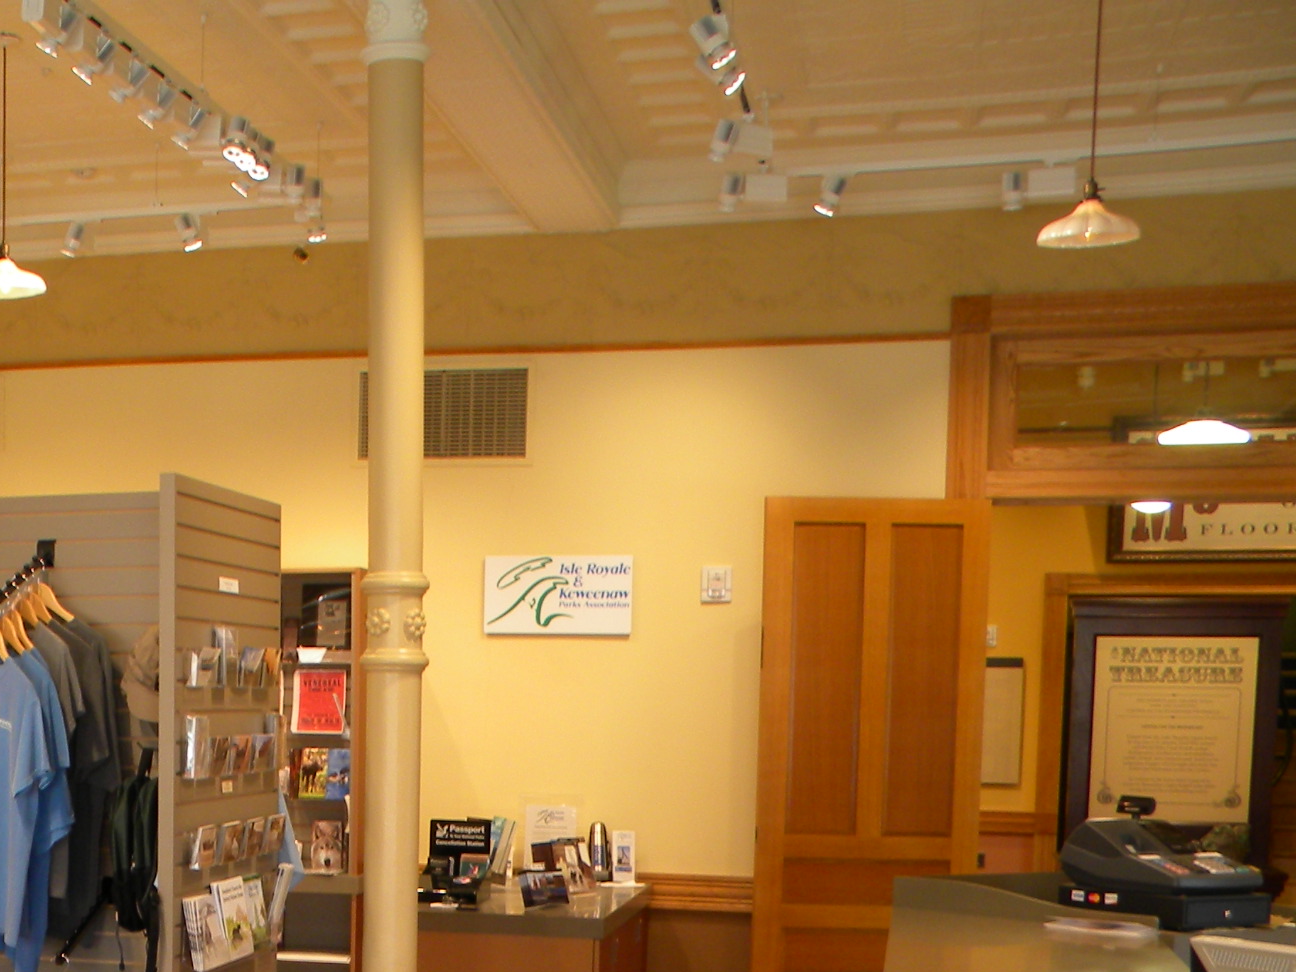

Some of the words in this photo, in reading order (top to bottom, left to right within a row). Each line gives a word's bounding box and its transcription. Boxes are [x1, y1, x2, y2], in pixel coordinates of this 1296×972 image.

[560, 563, 582, 575] Isle
[587, 563, 630, 577] Royale
[573, 576, 583, 587] &
[559, 588, 629, 599] Keweenaw
[1120, 646, 1244, 664] NATIONAL
[1109, 665, 1243, 684] TREASURE
[450, 823, 485, 835] Passport
